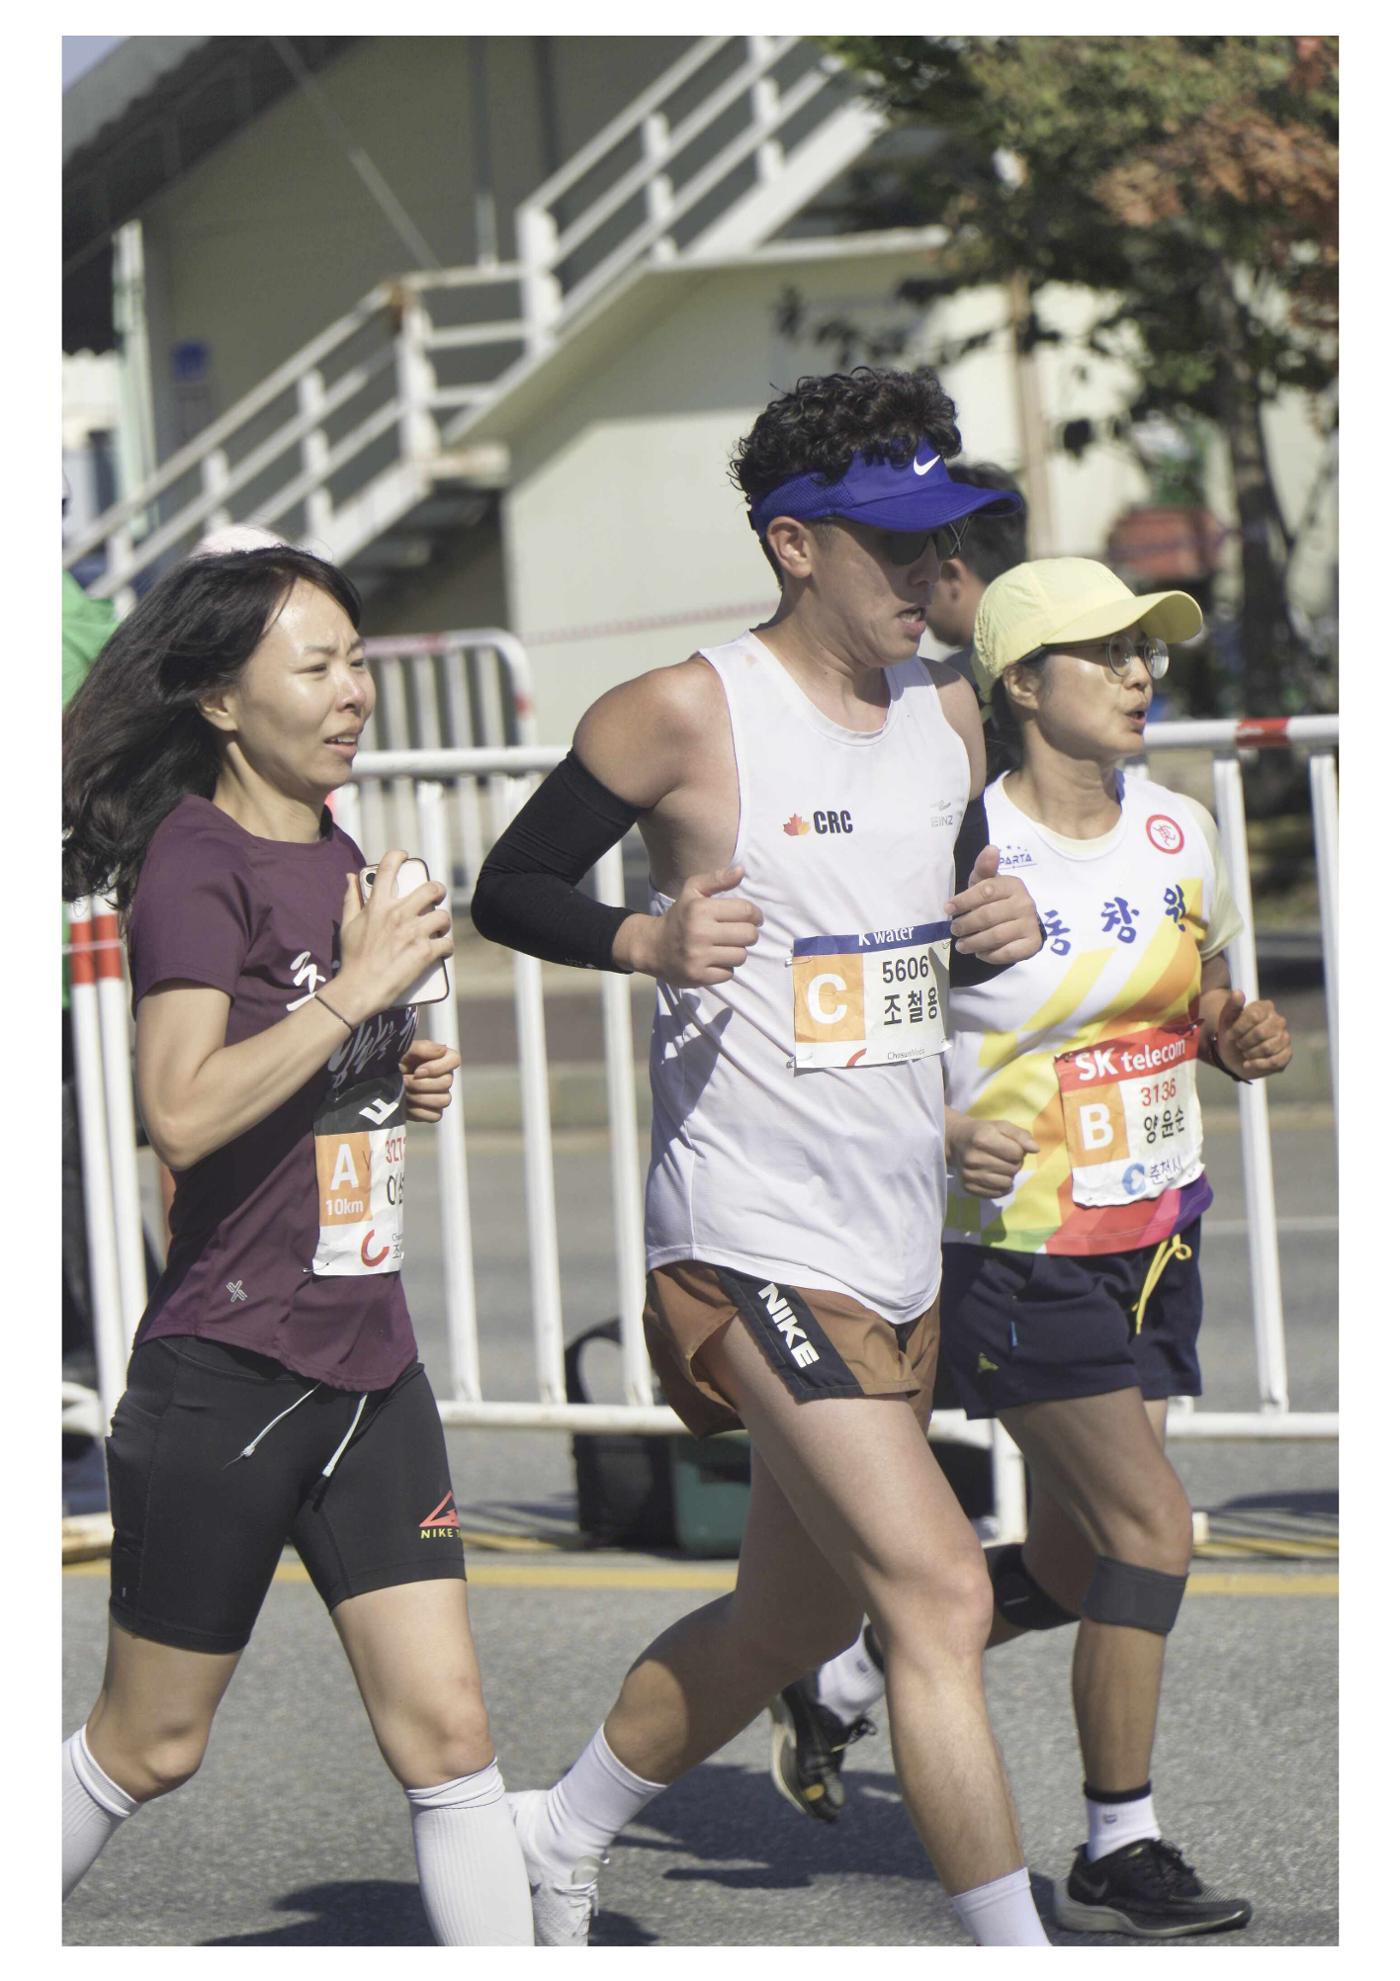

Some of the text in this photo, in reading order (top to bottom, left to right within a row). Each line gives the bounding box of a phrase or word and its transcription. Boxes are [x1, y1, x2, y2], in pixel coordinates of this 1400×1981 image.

[813, 810, 854, 834] CRC
[999, 853, 1033, 865] PARTA
[882, 955, 929, 984] 5606
[808, 973, 848, 1024] C
[883, 987, 938, 1026] 조철용
[1075, 1039, 1187, 1081] SK telecom
[1141, 1078, 1178, 1107] 3136
[1079, 1103, 1115, 1151] B
[330, 1143, 360, 1190] A
[326, 1197, 364, 1216] 10km
[758, 1283, 820, 1368] NIKE
[420, 1527, 454, 1539] NIKE
